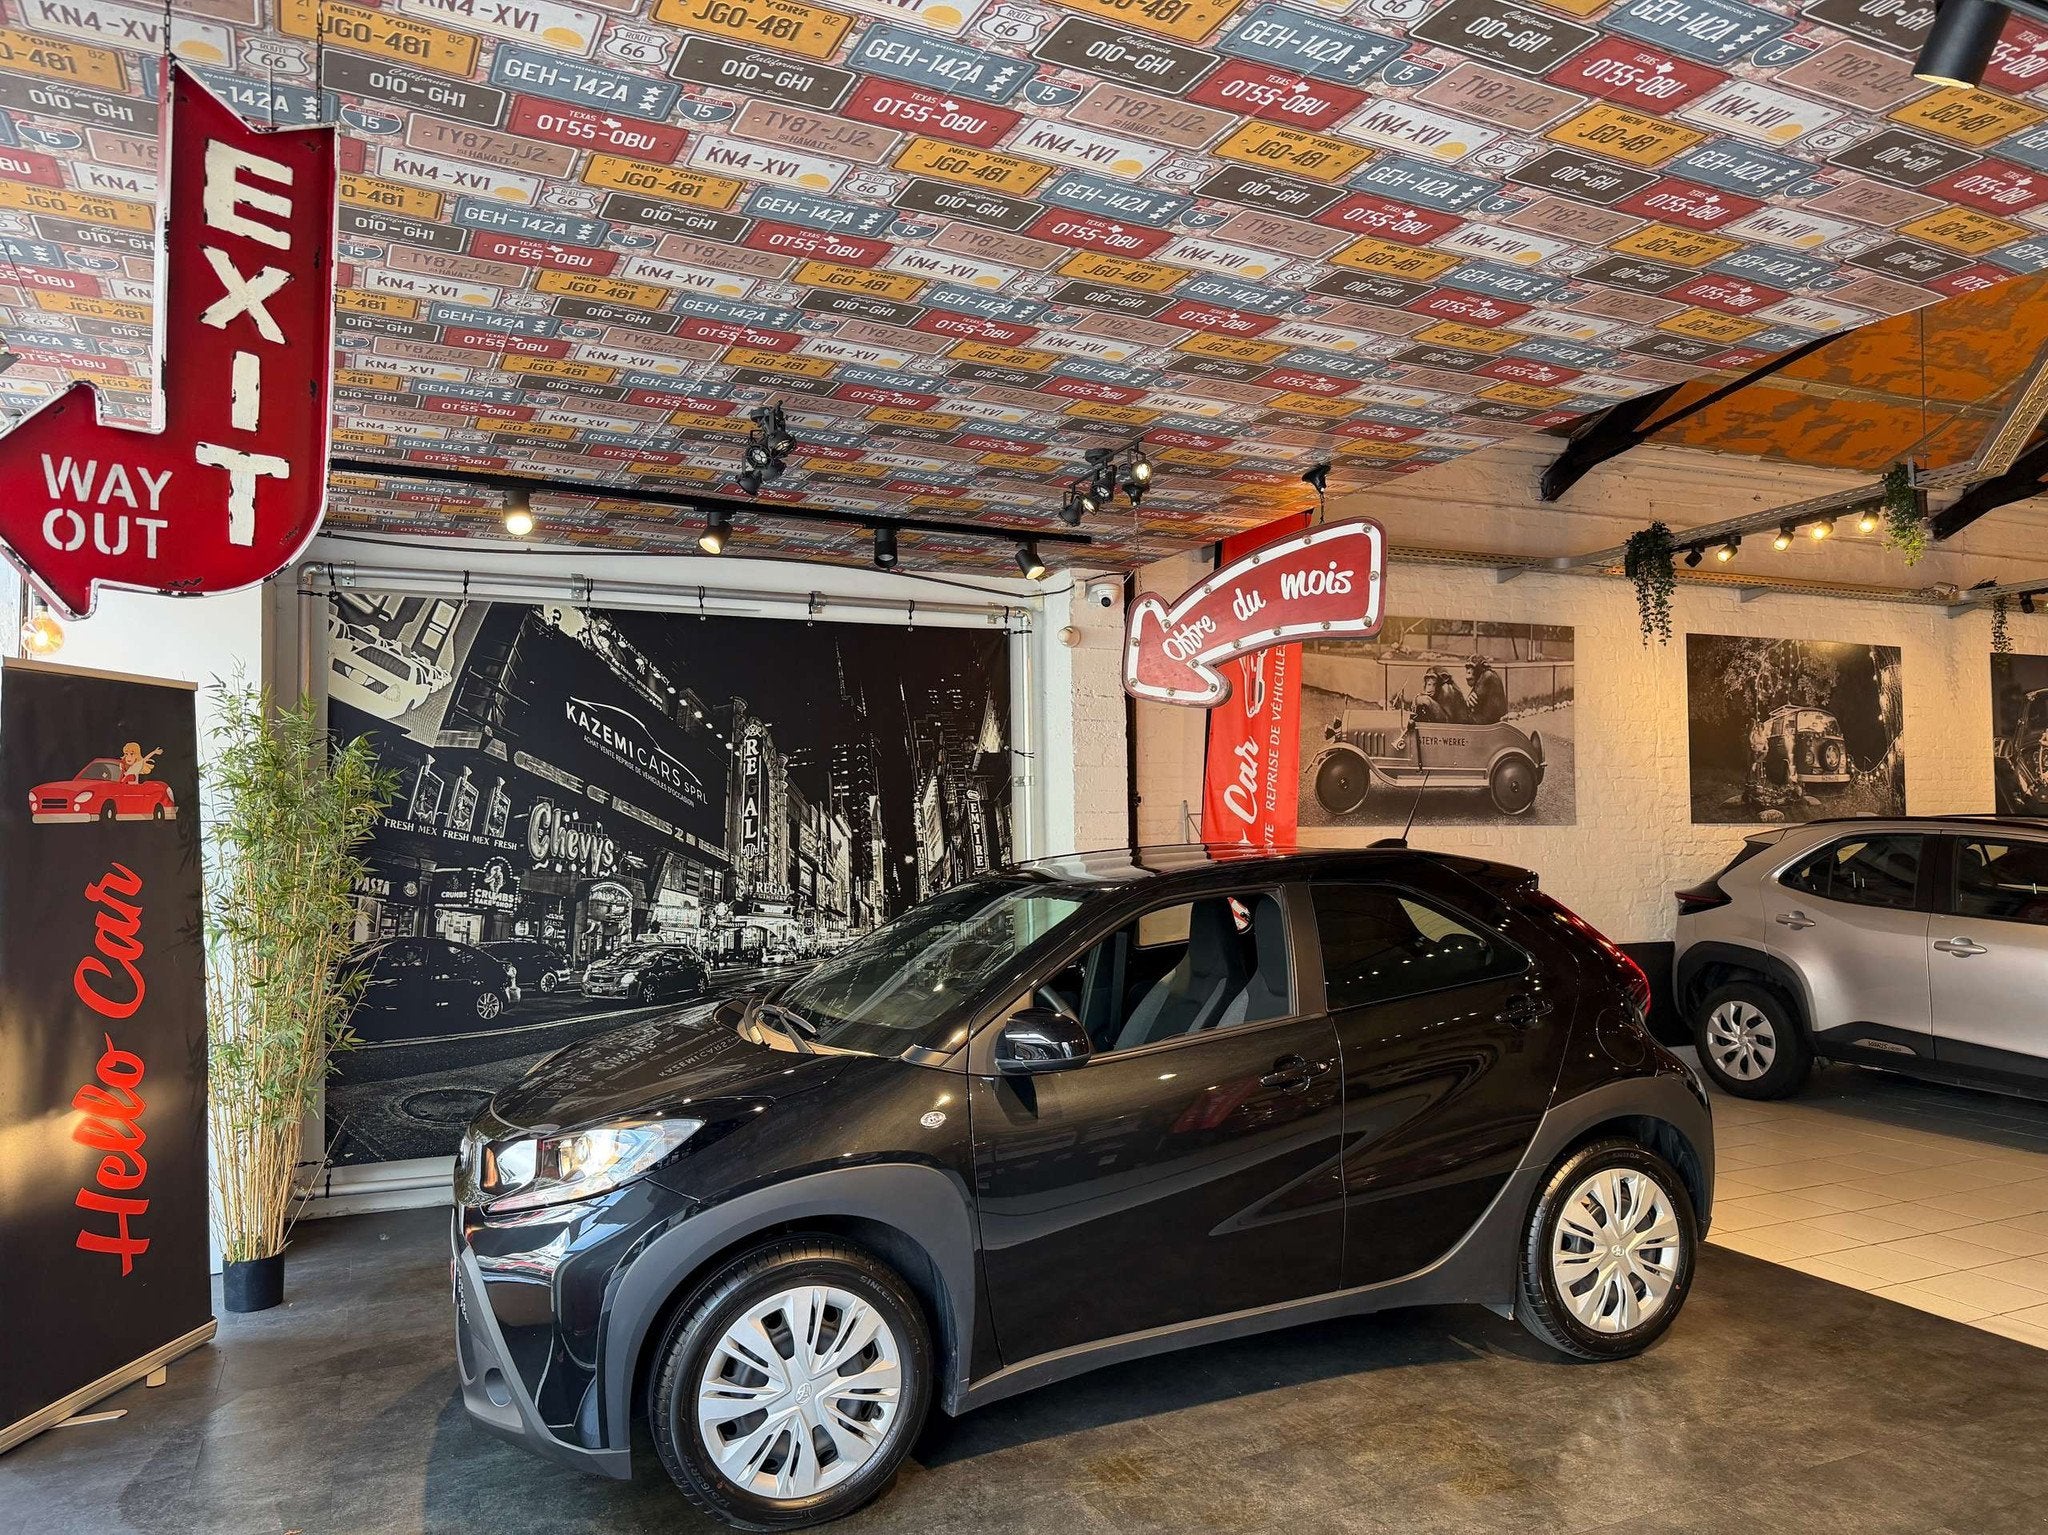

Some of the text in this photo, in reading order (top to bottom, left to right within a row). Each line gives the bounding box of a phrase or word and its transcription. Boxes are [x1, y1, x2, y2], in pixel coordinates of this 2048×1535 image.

[330, 4, 432, 36] NEW YORK
[822, 14, 841, 27] 82
[1003, 8, 1032, 20] ROUTE
[626, 31, 653, 43] ROUTE
[990, 20, 1023, 37] 66
[16, 34, 70, 50] YORK
[257, 42, 286, 54] ROUTE
[447, 34, 465, 46] 82
[622, 42, 646, 58] 66
[1236, 20, 1356, 64] GEH-142A
[260, 54, 287, 70] 66
[862, 40, 984, 83] GEH-142A
[1630, 53, 1661, 66] TEXAS
[1762, 44, 1798, 61] 15
[504, 58, 628, 102] GEH-142A
[1263, 74, 1294, 86] TEXAS
[1393, 64, 1424, 80] 15
[909, 92, 939, 104] TEXAS
[1037, 85, 1063, 100] 15
[569, 110, 597, 121] TEXAS
[693, 105, 712, 118] 15
[1612, 113, 1681, 136] NEW YORK
[37, 131, 62, 145] 15
[1273, 130, 1346, 152] NEW YORK
[1482, 152, 1512, 164] 66
[1682, 150, 1778, 182] GEH-142A
[629, 162, 709, 182] NEW YORK
[1362, 167, 1460, 198] GEH-142A
[854, 182, 880, 194] 66
[1053, 183, 1152, 212] GEH-142A
[464, 207, 565, 235] GEH-142A
[754, 196, 854, 224] GEH-142A
[1722, 253, 1804, 276] GEH-142A
[1450, 269, 1533, 291] GEH-142A
[681, 300, 766, 321] GEH-142A
[196, 138, 293, 546] EXIT
[41, 451, 173, 511] WAY
[43, 509, 168, 559] OUT
[1233, 588, 1267, 621] du
[1280, 561, 1354, 600] mois
[584, 734, 600, 749] ACHAT
[600, 744, 616, 760] VENTE
[1268, 725, 1281, 747] DE
[744, 739, 759, 838] REGAL
[1223, 736, 1259, 824] Car
[1265, 750, 1279, 811] REPRISE
[684, 782, 709, 805] SPRL
[384, 818, 414, 832] FRESH
[418, 825, 438, 836] MEX
[443, 829, 470, 842] FRESH
[472, 835, 490, 846] MEX
[493, 839, 518, 851] FRESH
[528, 801, 615, 877] Chevys
[970, 803, 984, 867] EMPIRE
[355, 876, 390, 896] PASTA
[474, 888, 514, 903] CRUMBS
[71, 861, 150, 1277] Hello Car
